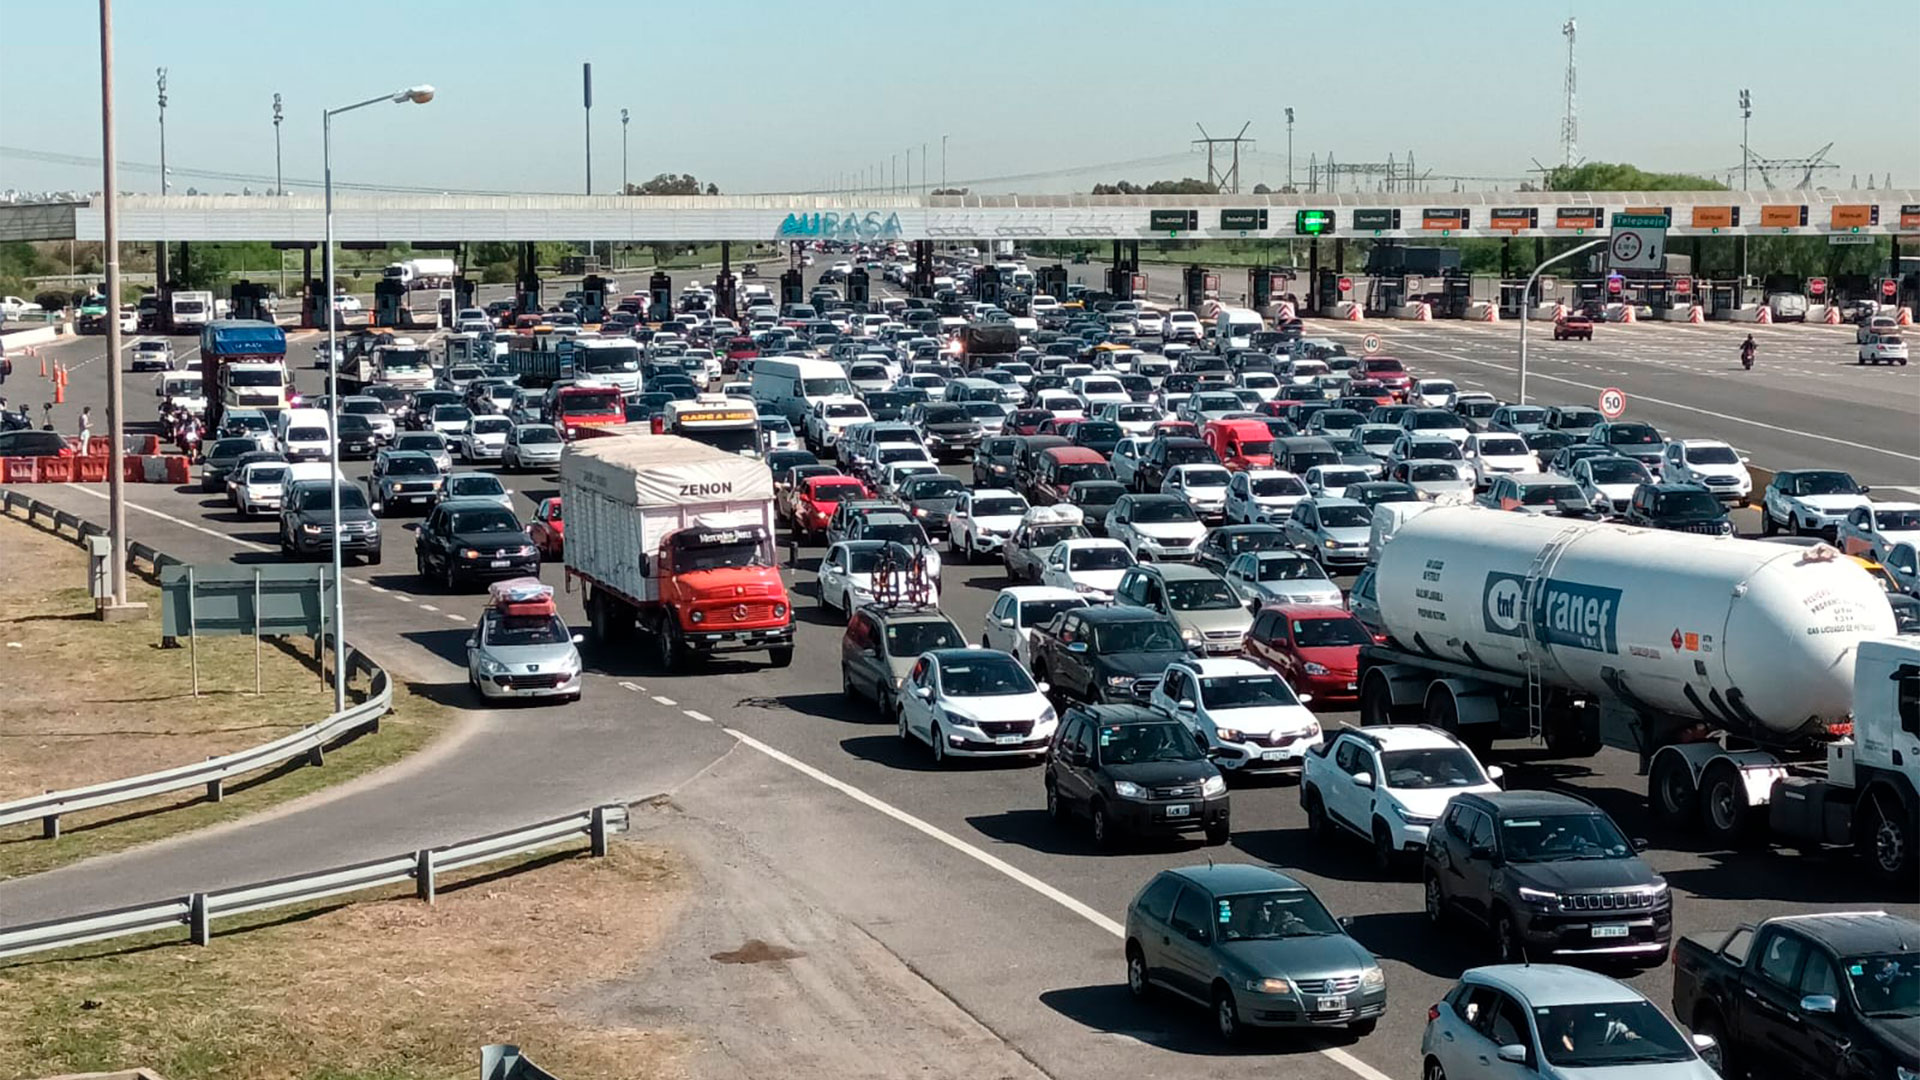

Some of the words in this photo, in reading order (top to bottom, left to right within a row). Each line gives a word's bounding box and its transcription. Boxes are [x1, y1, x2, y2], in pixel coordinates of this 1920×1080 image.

[780, 211, 903, 236] AUBASA
[1365, 339, 1378, 348] 40
[1605, 396, 1620, 409] 50
[679, 481, 732, 496] ZENON
[1497, 590, 1516, 619] tnf
